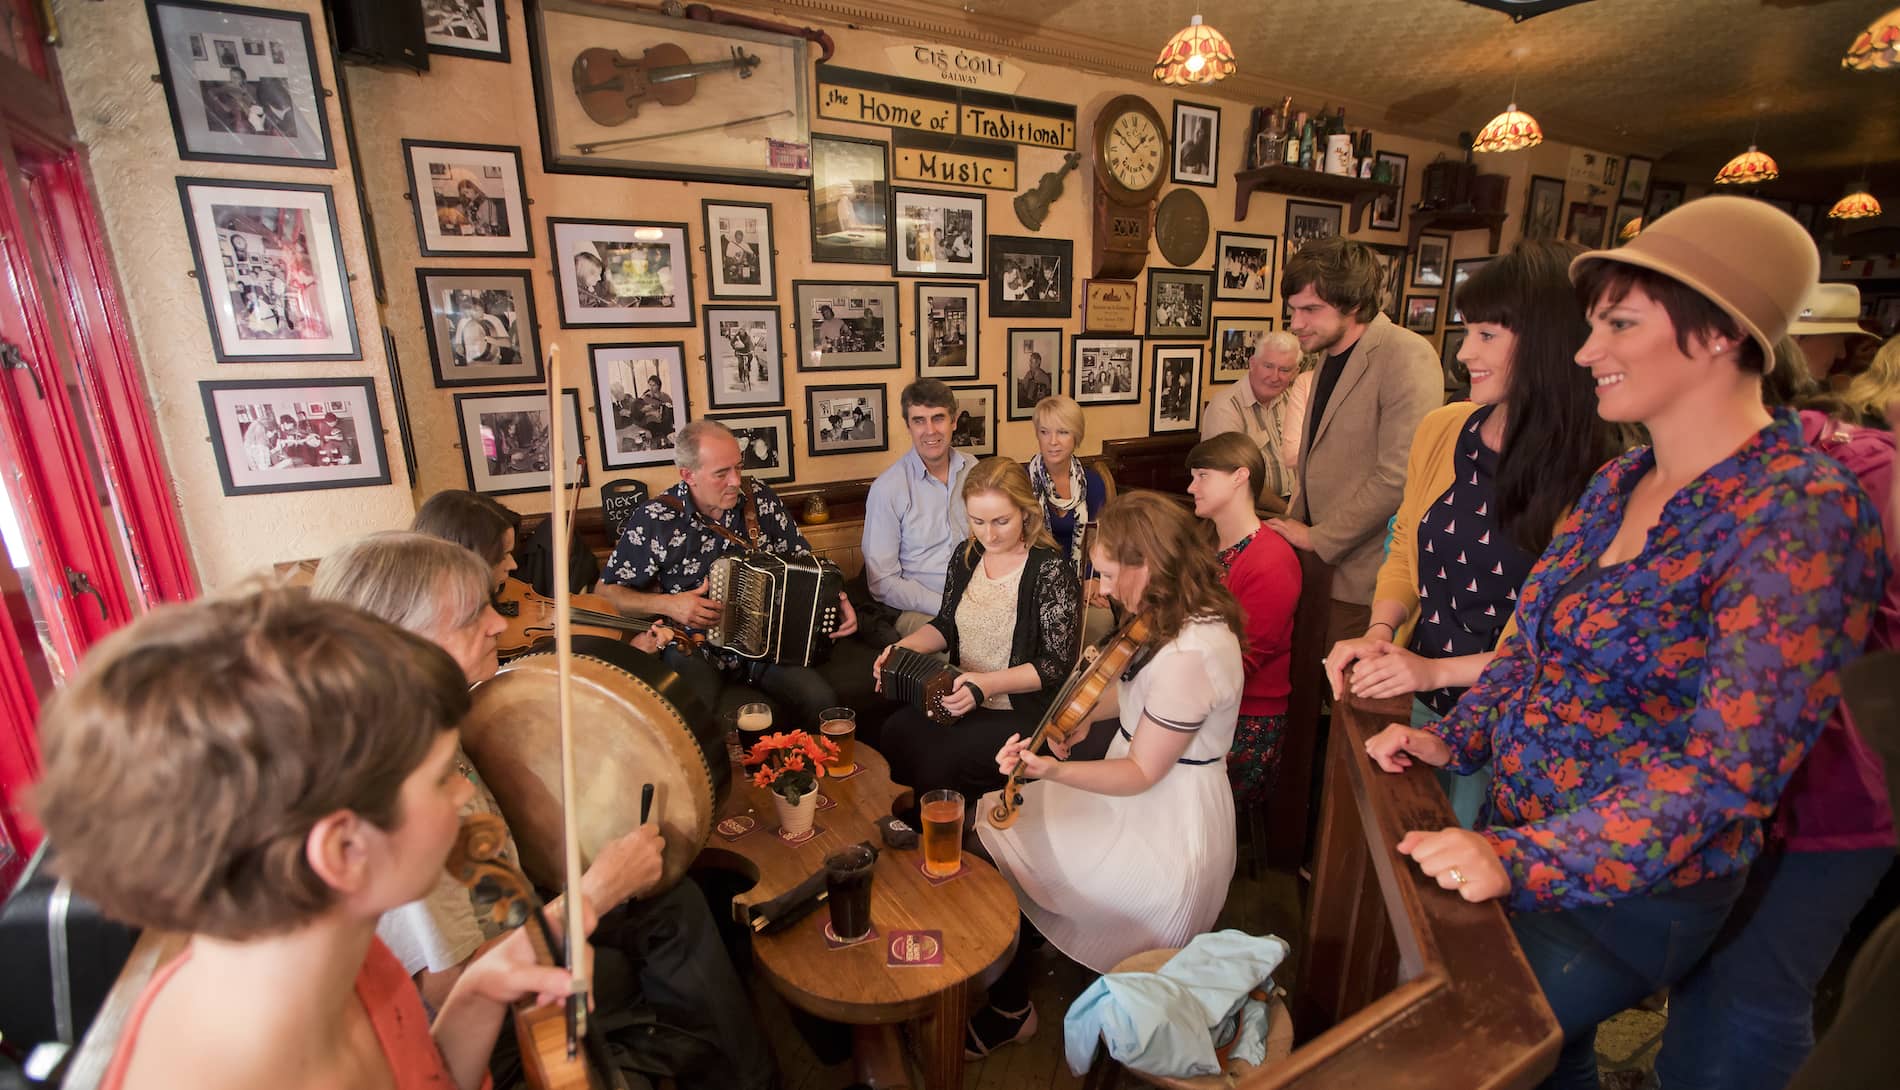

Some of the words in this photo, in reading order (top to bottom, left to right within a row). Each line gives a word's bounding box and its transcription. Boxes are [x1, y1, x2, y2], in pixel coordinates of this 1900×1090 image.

[941, 71, 978, 84] GALWAY
[829, 89, 849, 106] the
[859, 93, 922, 127] Home
[930, 115, 949, 130] of
[969, 109, 1065, 146] Traditional
[919, 152, 993, 185] Music
